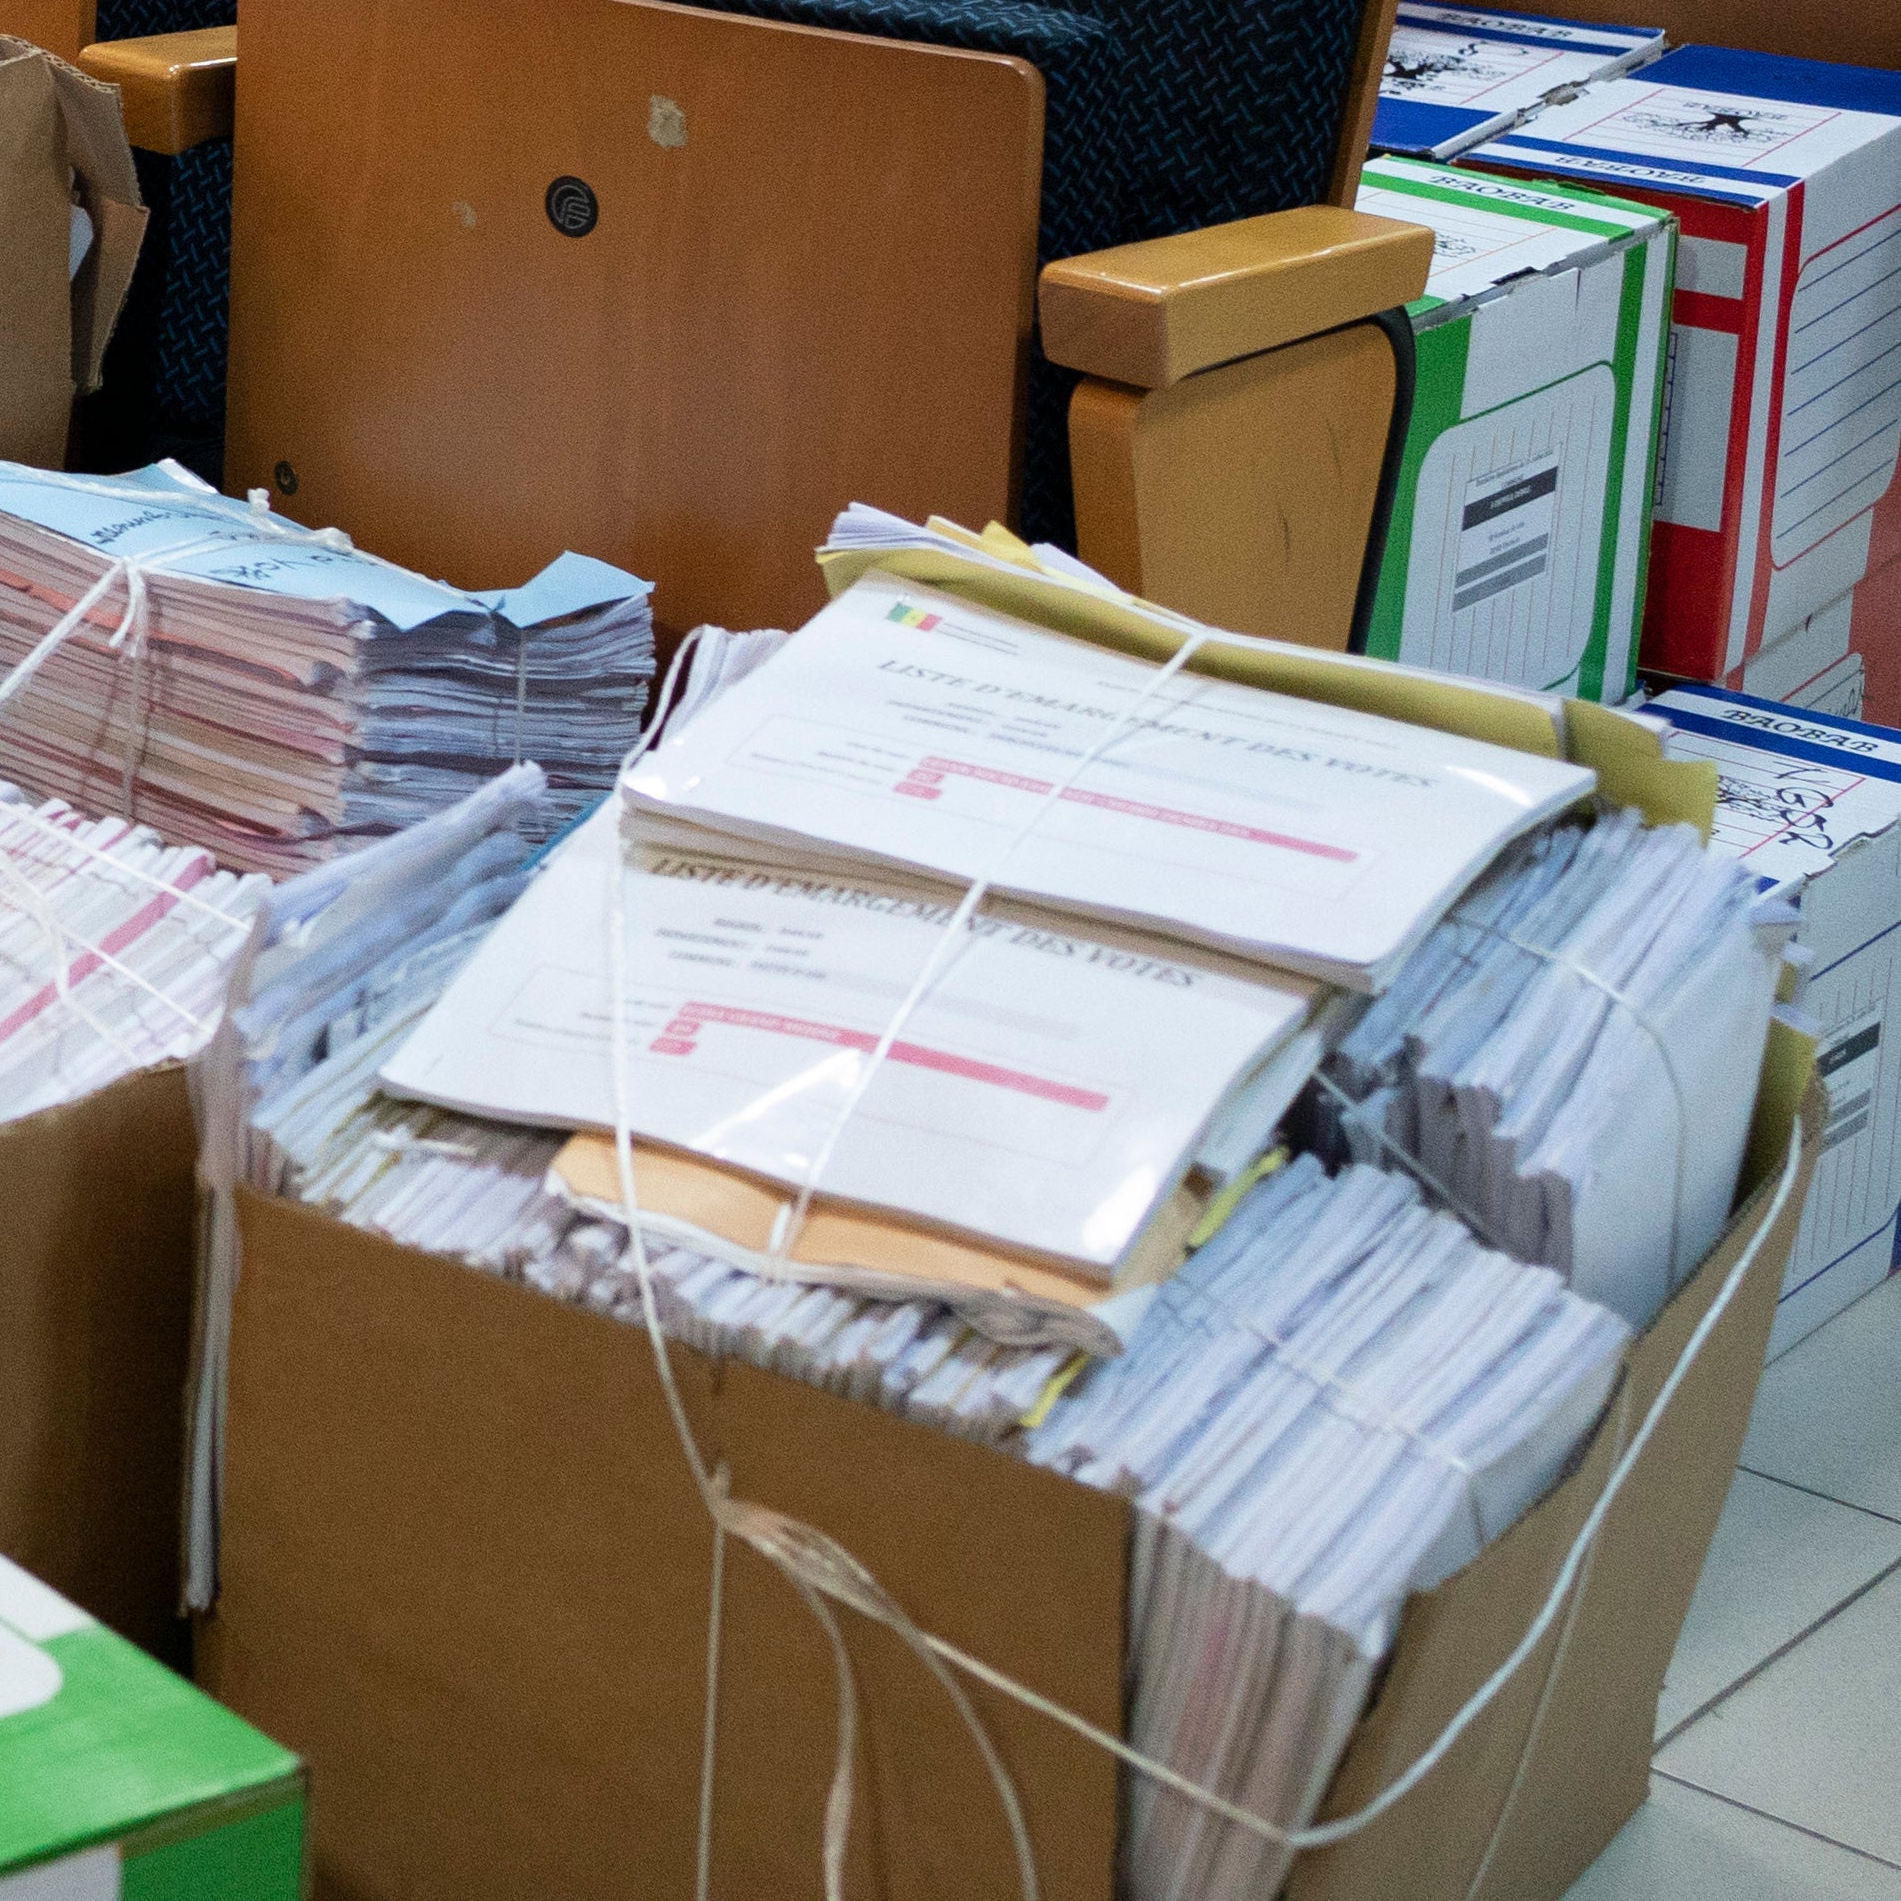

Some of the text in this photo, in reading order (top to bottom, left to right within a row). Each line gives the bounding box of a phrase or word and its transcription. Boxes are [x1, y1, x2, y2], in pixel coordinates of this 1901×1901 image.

[1430, 174, 1576, 212] BAOBAB
[1555, 154, 1707, 186] BAOBAB
[877, 659, 967, 688] LISTE
[1246, 740, 1322, 763] DES
[1325, 757, 1440, 789] VOTES
[1722, 708, 1879, 754] BAOBAB
[649, 857, 737, 886] LISTE
[1008, 927, 1075, 958] DES
[1087, 947, 1195, 989] VOTES
